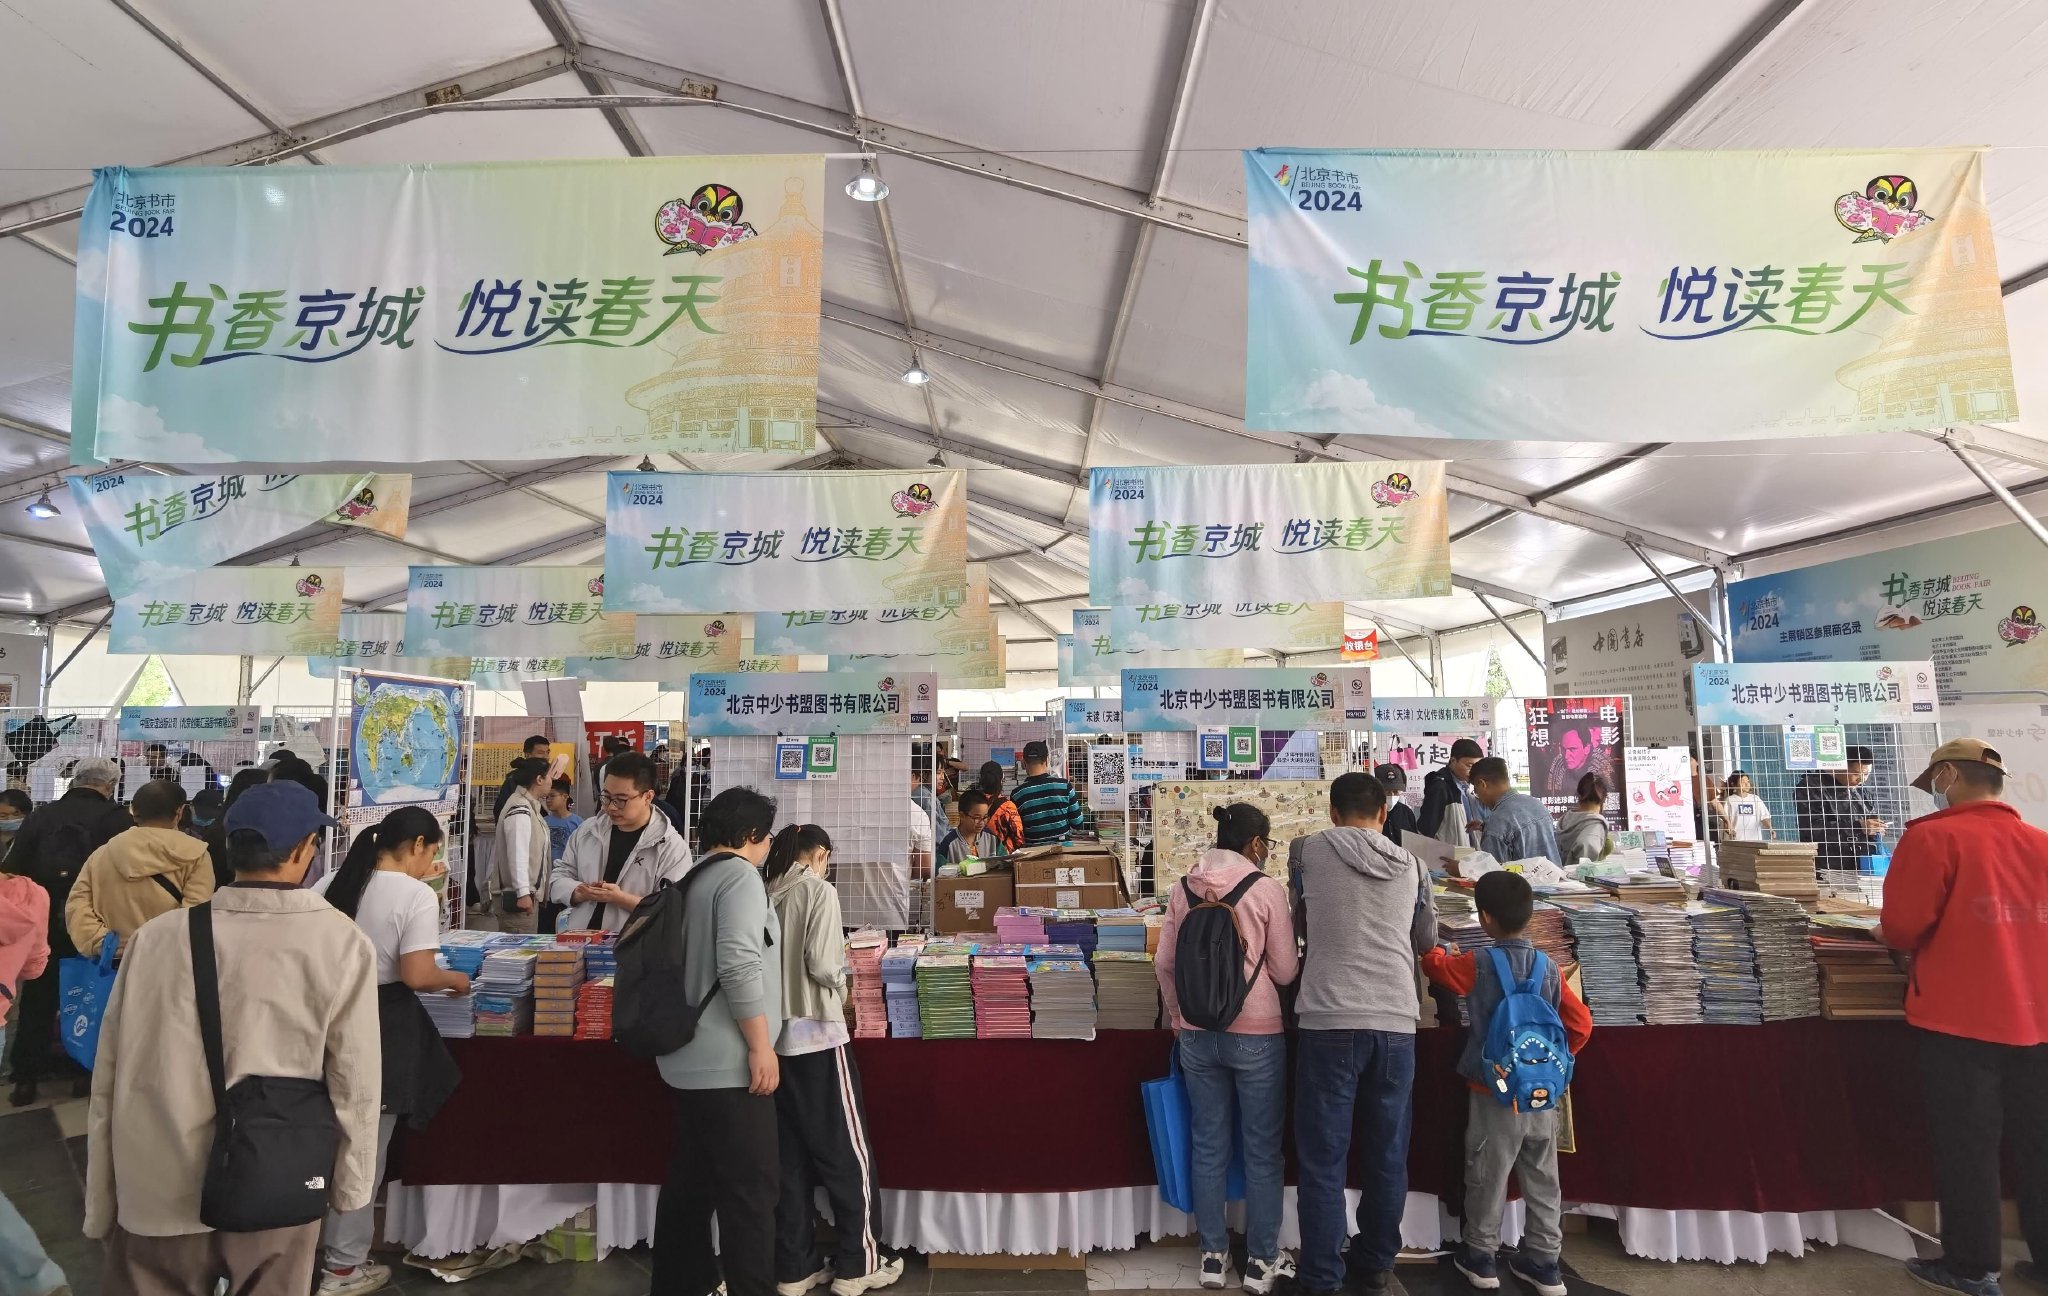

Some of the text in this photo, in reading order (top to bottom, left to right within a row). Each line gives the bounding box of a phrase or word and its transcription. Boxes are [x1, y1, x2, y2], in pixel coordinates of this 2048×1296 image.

[1301, 166, 1359, 184] 北京书市
[116, 191, 175, 209] 北京书市
[1298, 189, 1363, 211] 2024
[110, 210, 174, 238] 2024
[1333, 258, 1920, 346] 书香京城 悦读春天
[127, 274, 730, 373] 书香京城 悦读春天
[95, 475, 126, 493] 2024
[1114, 488, 1145, 500] 2024
[123, 474, 247, 548] 书香京城
[633, 494, 664, 506] 2024
[644, 526, 929, 571] 书香京城 悦读春天
[1127, 515, 1408, 565] 书香京城 悦读春天
[423, 580, 443, 588] 2024
[1879, 571, 1953, 610] 书香京城
[137, 600, 316, 629] 书香京城 悦读春天
[431, 601, 607, 630] 书香京城 悦读春天
[1920, 592, 1985, 622] 悦读春天
[1750, 612, 1780, 631] 2024
[655, 640, 721, 660] 悦读春天
[471, 656, 565, 675] 书香京城 悦读春
[704, 687, 727, 696] 2024
[1137, 682, 1159, 691] 2024
[1708, 677, 1730, 686] 2024
[725, 693, 901, 715] 北京中少书盟图书有限公司
[1159, 689, 1336, 710] 北京中少书盟图书有限公司
[1731, 682, 1902, 704] 北京中少书盟图书有限公司
[1528, 707, 1550, 748] 狂想
[1599, 704, 1621, 746] 电影
[1739, 804, 1753, 814] Lee
